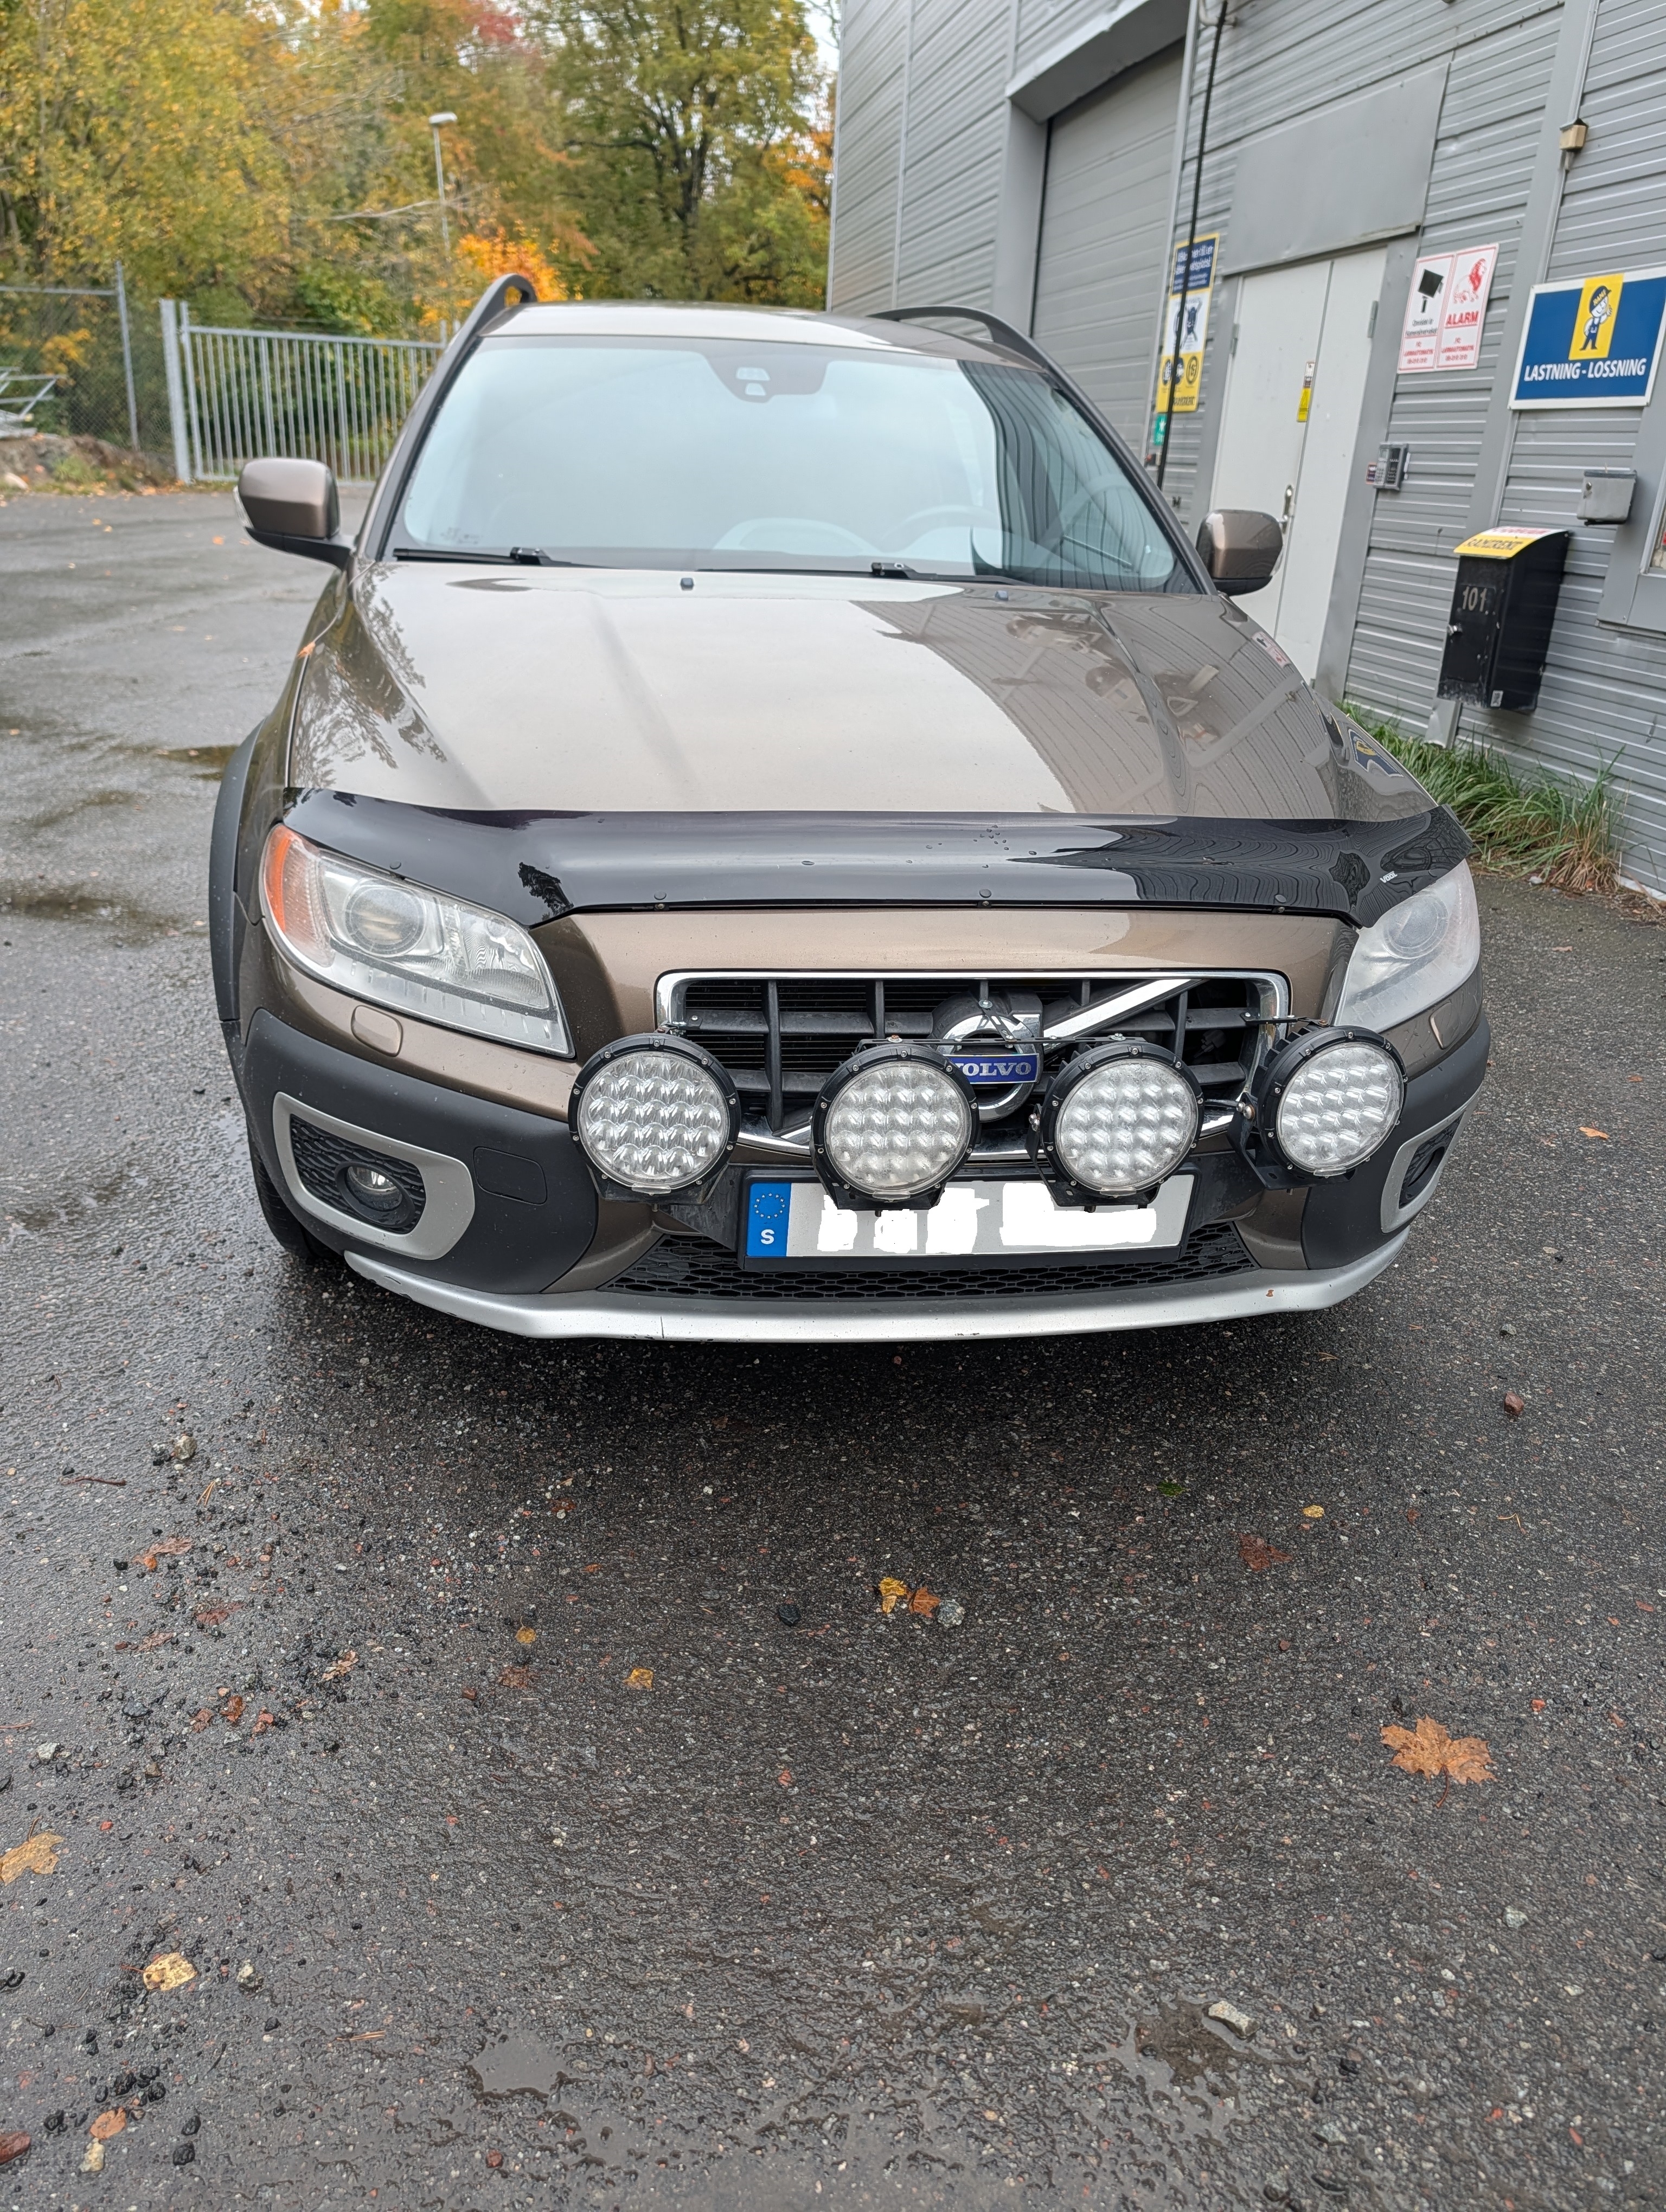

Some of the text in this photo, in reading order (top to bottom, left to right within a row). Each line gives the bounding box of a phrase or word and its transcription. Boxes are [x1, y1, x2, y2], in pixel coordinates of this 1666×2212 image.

[1446, 311, 1479, 324] ALARM
[1462, 586, 1487, 612] 101
[761, 1229, 775, 1245] S
